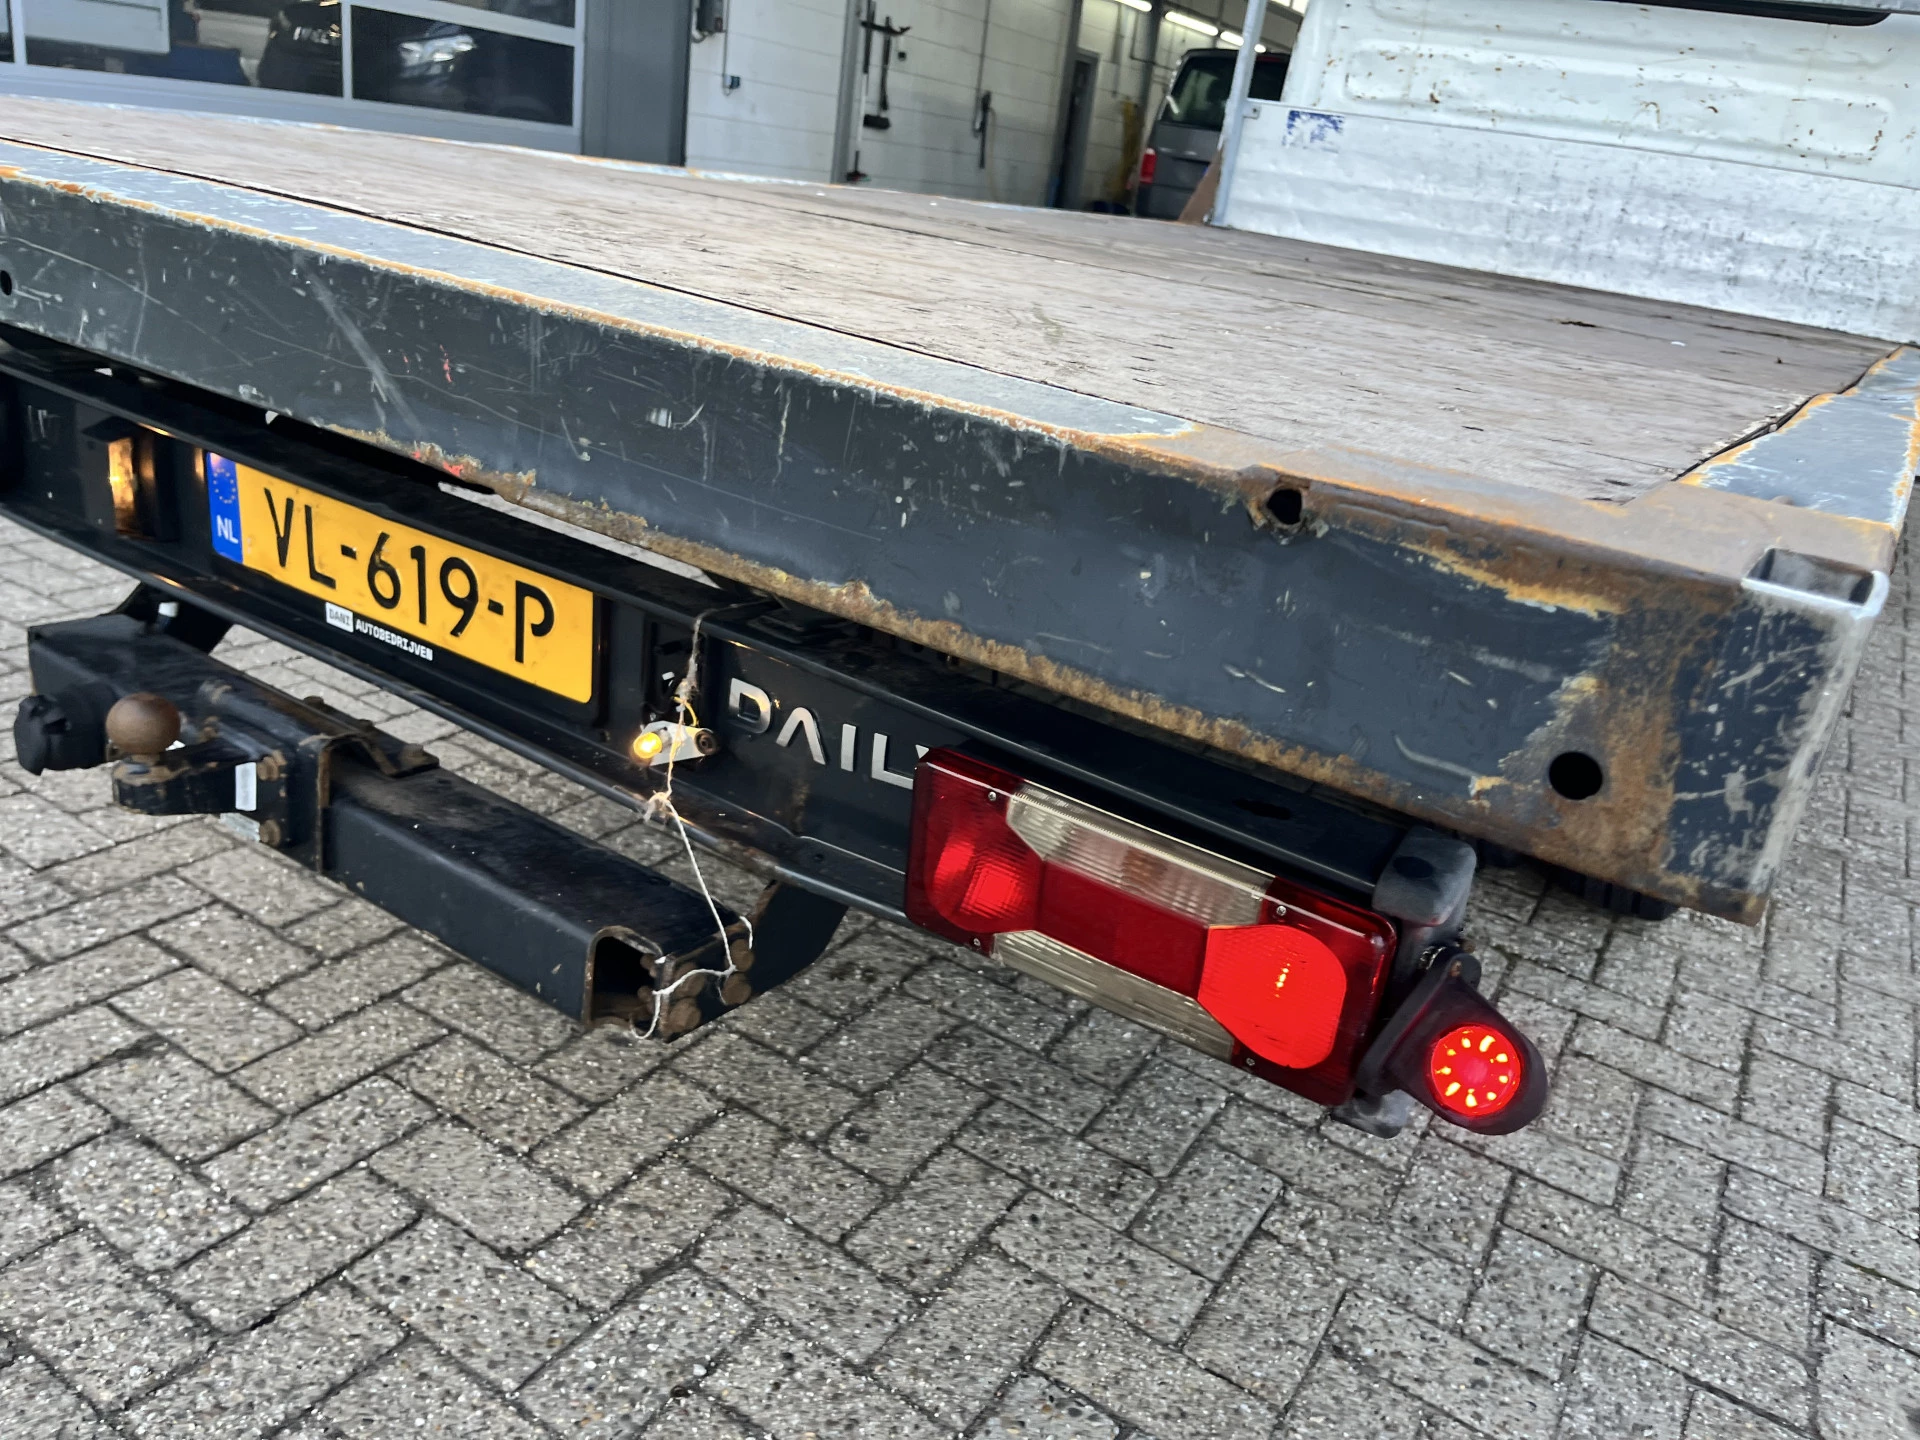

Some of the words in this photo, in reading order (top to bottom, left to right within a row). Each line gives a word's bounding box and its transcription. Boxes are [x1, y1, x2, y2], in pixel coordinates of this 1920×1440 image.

[217, 514, 239, 545] NL
[264, 487, 555, 664] VL-619-P
[328, 608, 351, 627] DANI
[355, 618, 434, 662] AUTOBEDRIJVEN
[729, 677, 930, 790] DAIL
